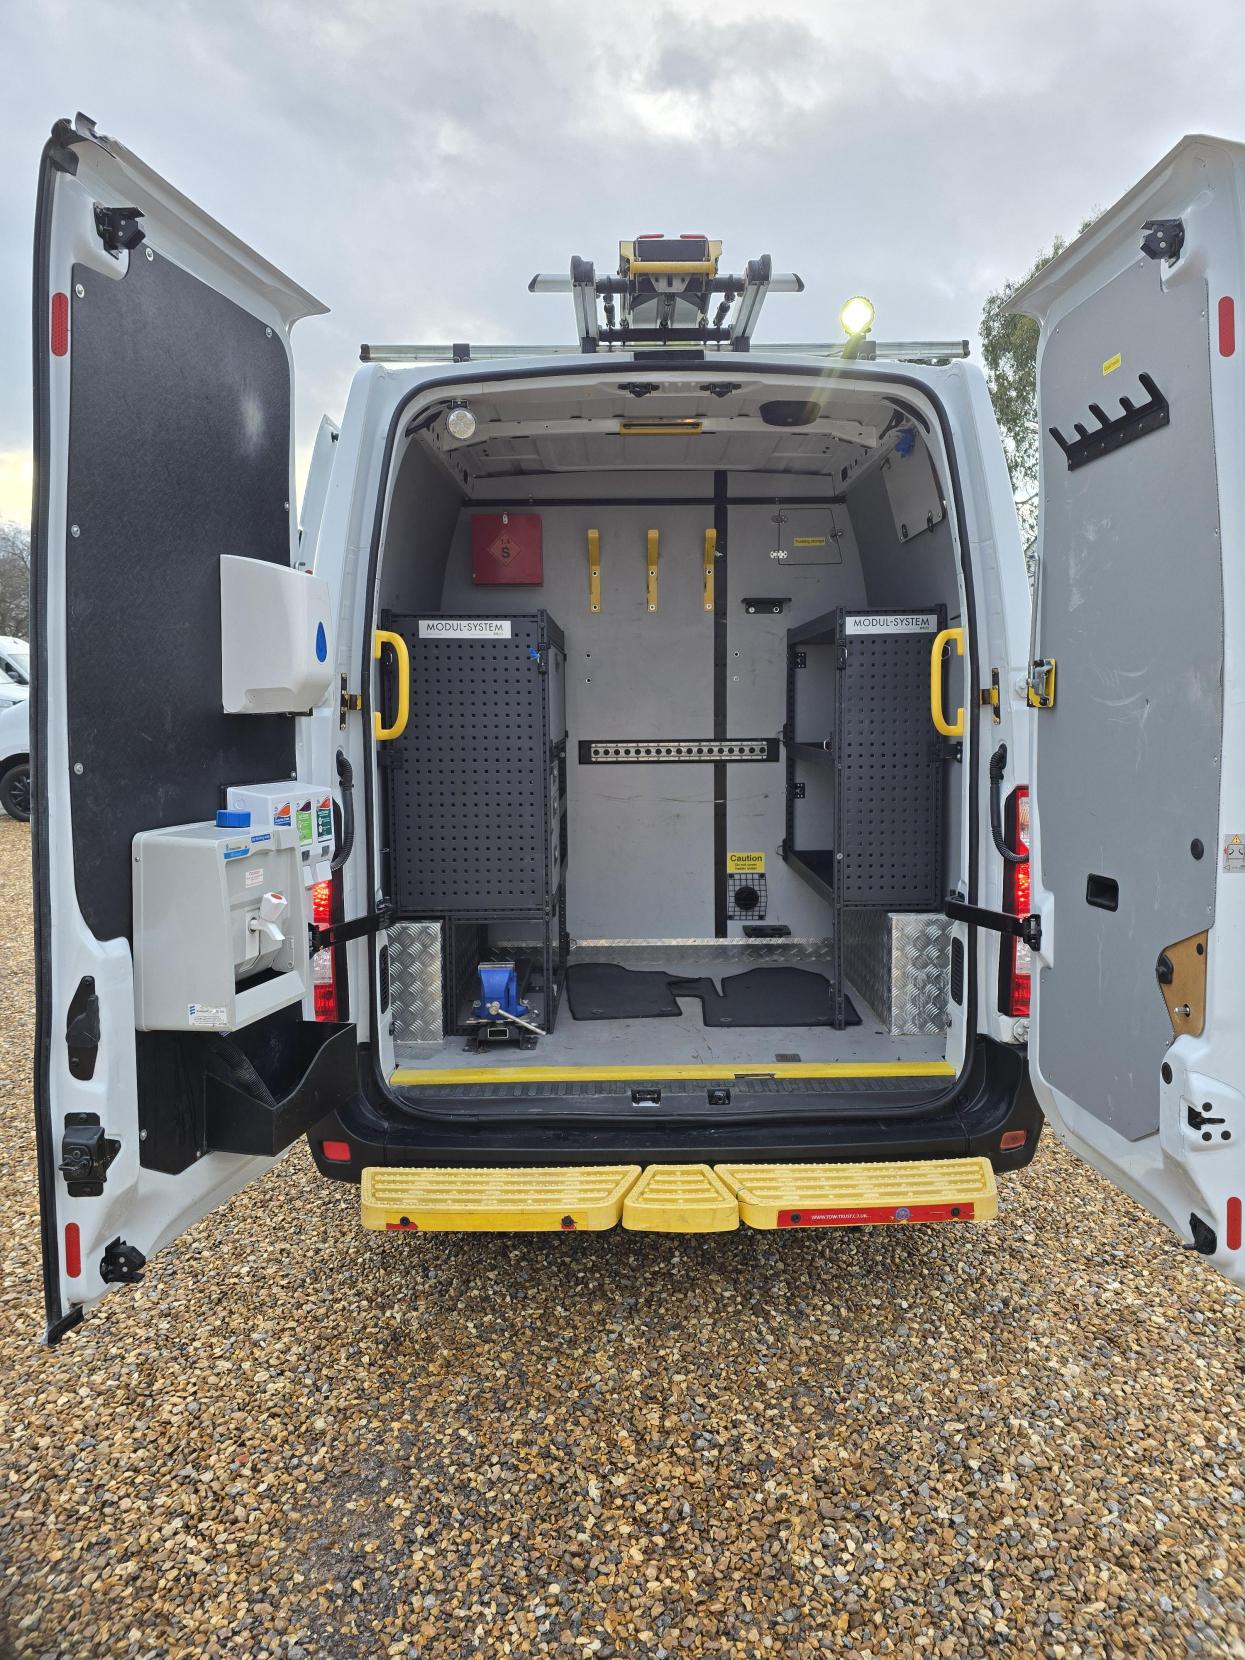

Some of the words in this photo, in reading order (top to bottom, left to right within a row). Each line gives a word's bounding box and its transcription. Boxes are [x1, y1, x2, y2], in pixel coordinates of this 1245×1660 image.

[501, 546, 510, 559] S
[426, 622, 503, 632] MODUL-SYSTEM
[853, 617, 930, 627] MODUL-SYSTEM
[730, 854, 763, 862] Caution
